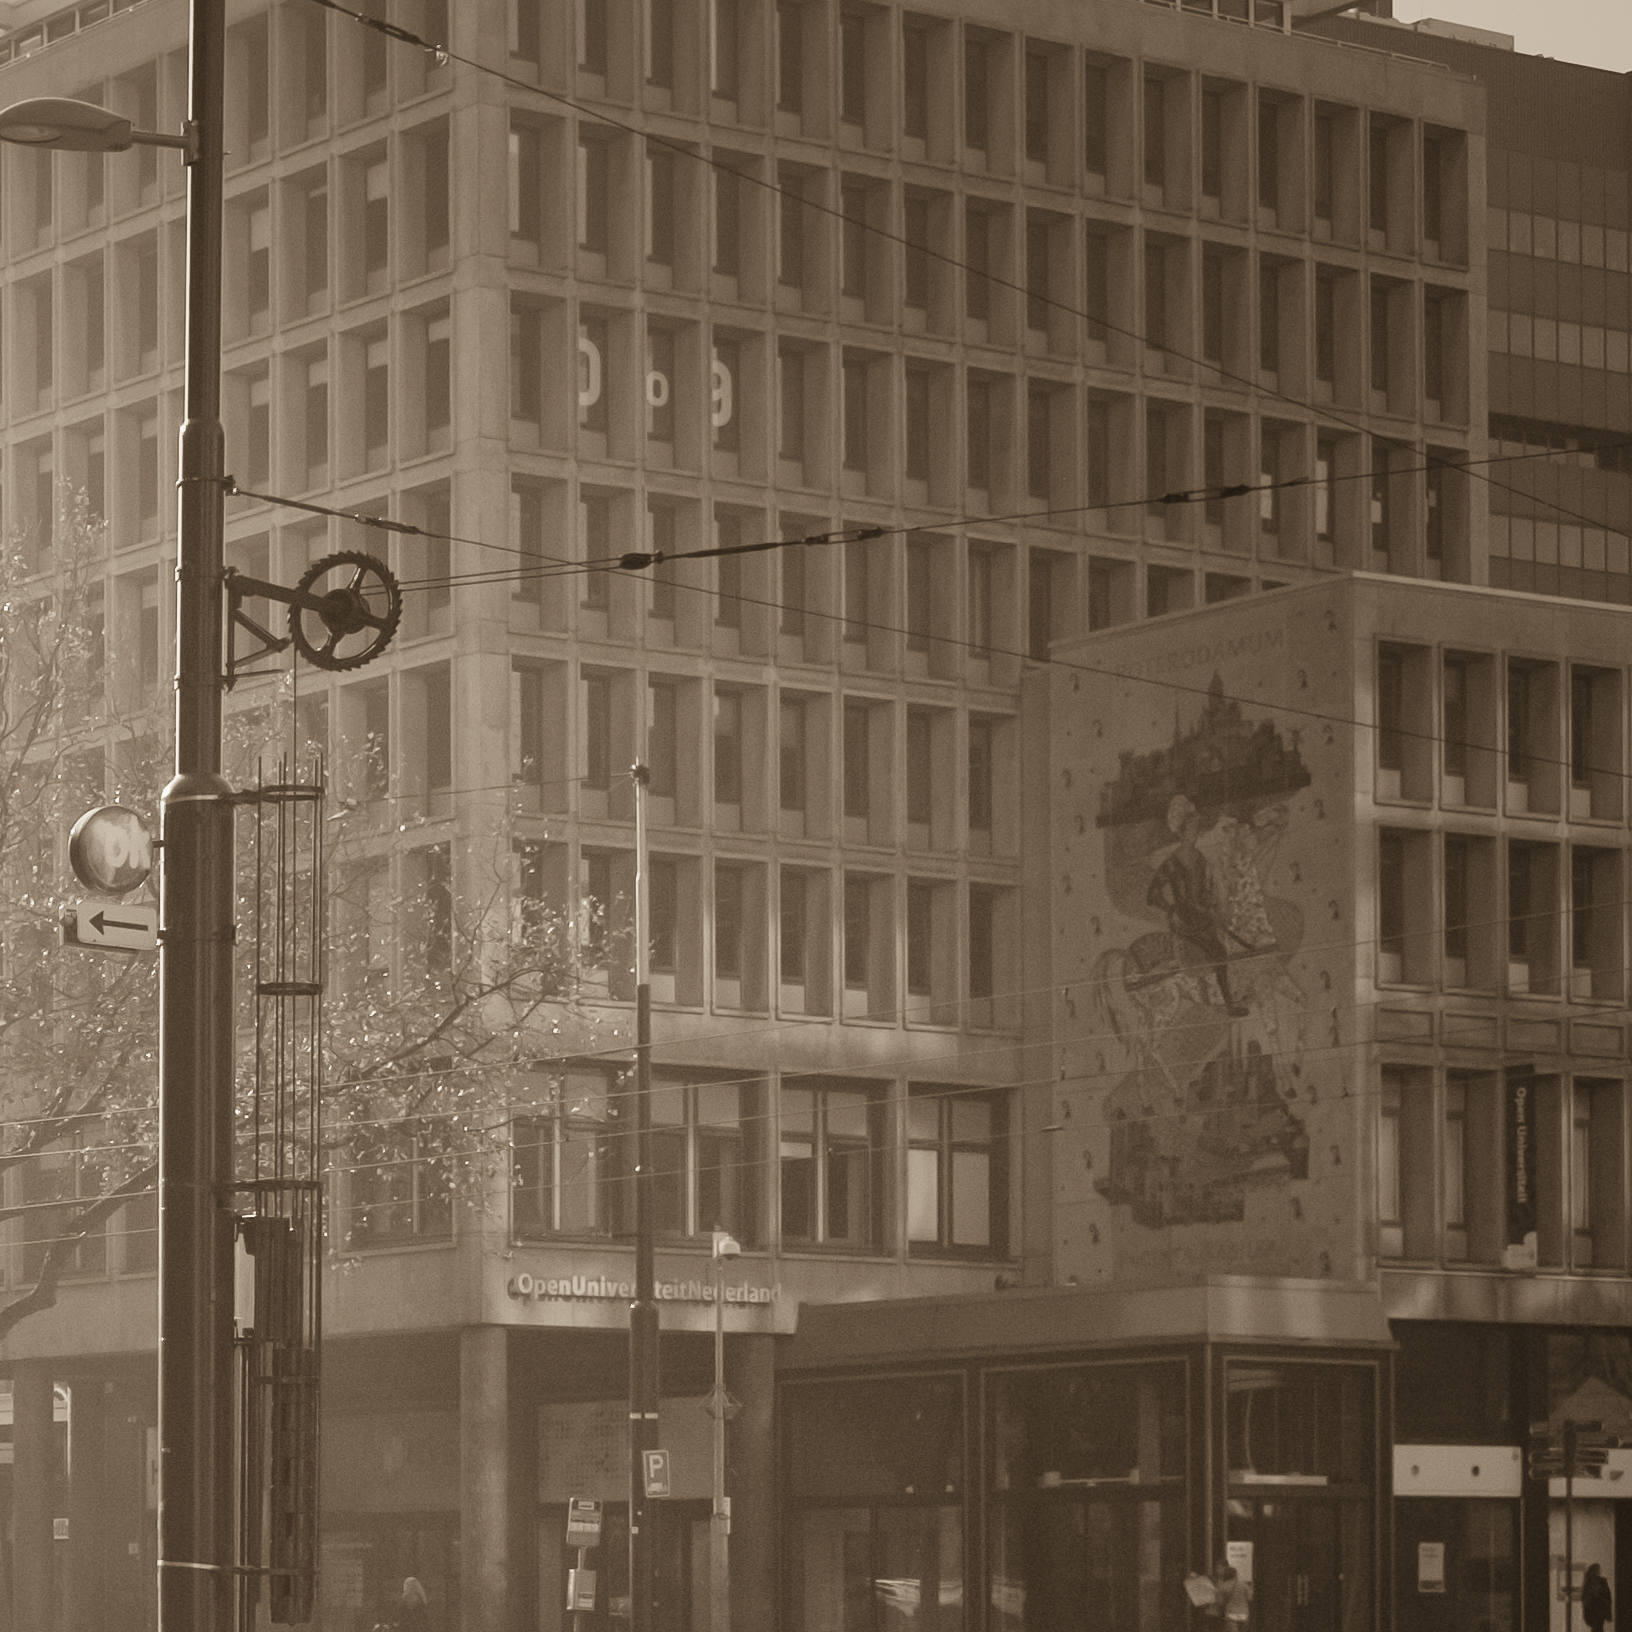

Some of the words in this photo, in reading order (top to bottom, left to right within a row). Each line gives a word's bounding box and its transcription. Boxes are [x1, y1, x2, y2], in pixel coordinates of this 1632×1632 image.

[1515, 1087, 1527, 1122] Open
[1515, 1126, 1527, 1203] Universiteit
[648, 1454, 664, 1478] P
